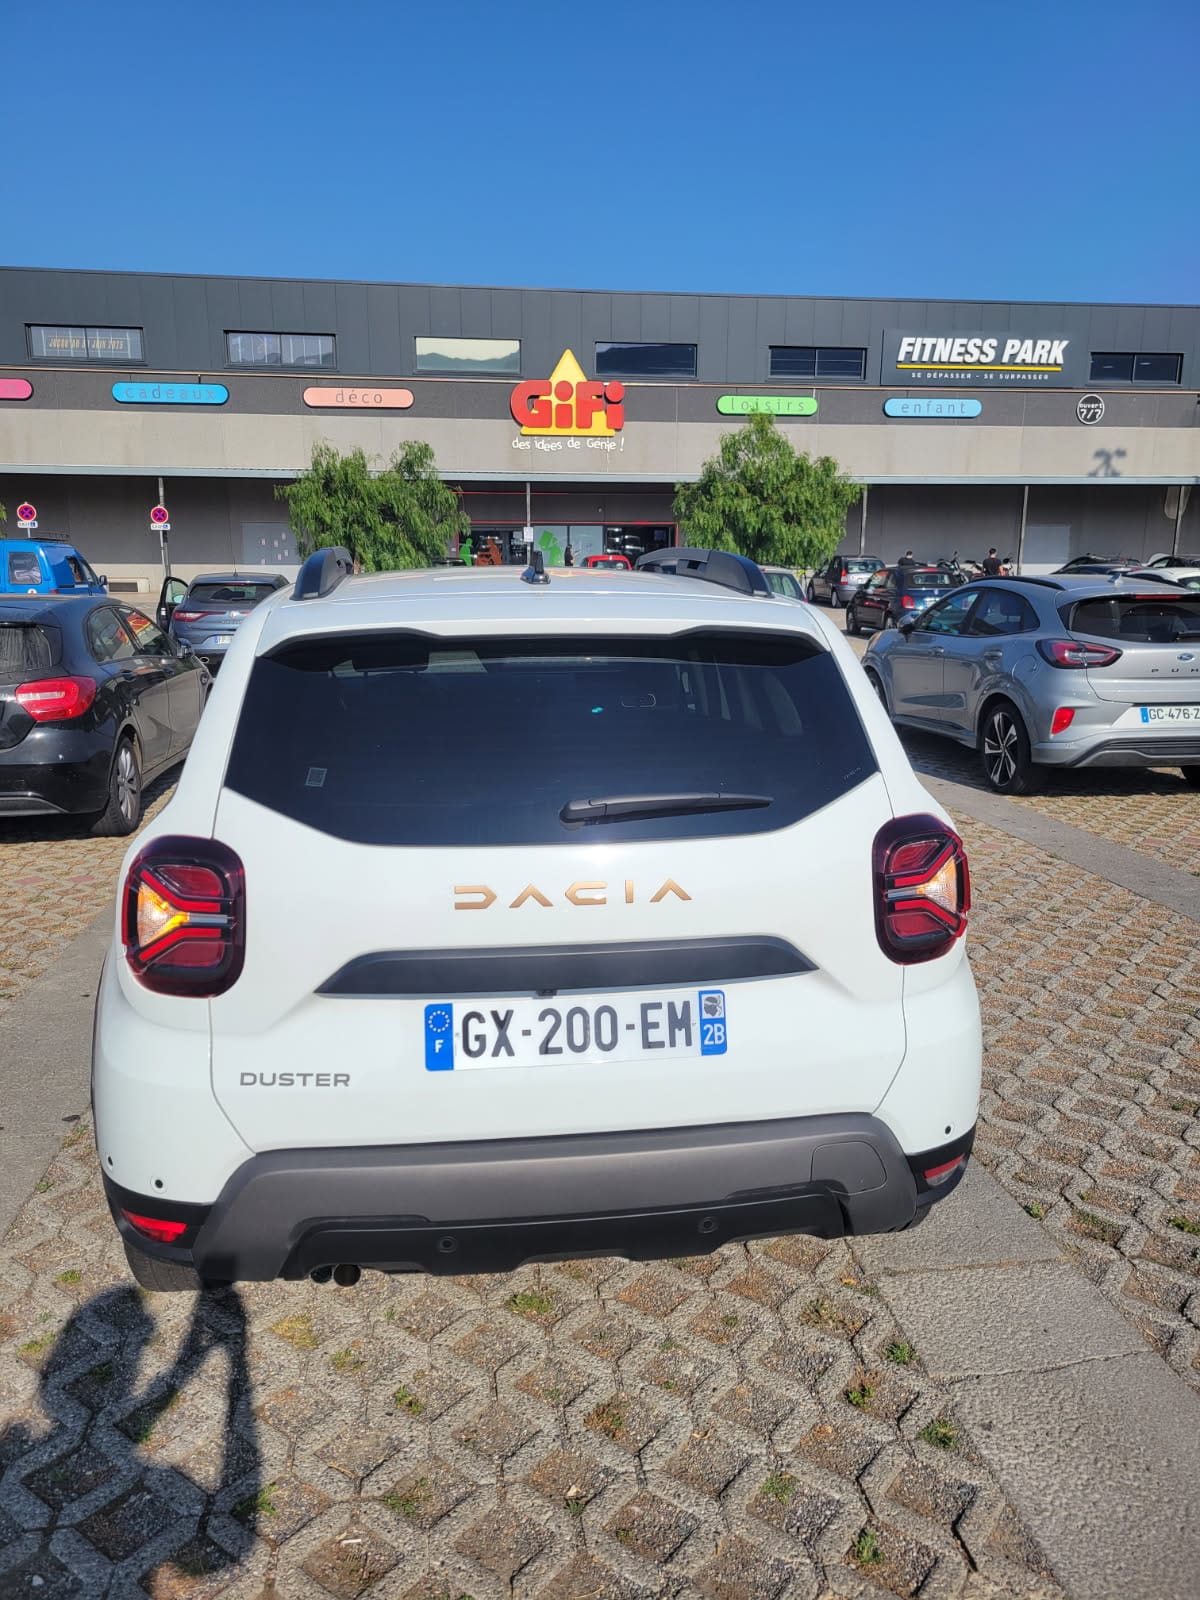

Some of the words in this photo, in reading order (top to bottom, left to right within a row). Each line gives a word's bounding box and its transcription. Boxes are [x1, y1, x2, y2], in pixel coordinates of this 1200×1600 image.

[897, 337, 998, 363] FITNESS
[1001, 339, 1070, 364] PARK
[926, 371, 972, 379] DÉPASSER
[125, 384, 217, 400] cadeaux
[335, 387, 383, 404] déco
[731, 397, 805, 412] loisirs
[901, 400, 966, 414] enfant
[1080, 408, 1101, 419] 7/7
[512, 437, 531, 450] des
[567, 436, 581, 449] de
[454, 878, 692, 910] DACIA
[703, 1023, 725, 1045] 2B
[435, 1039, 445, 1053] F
[240, 1072, 350, 1087] DUSTER
